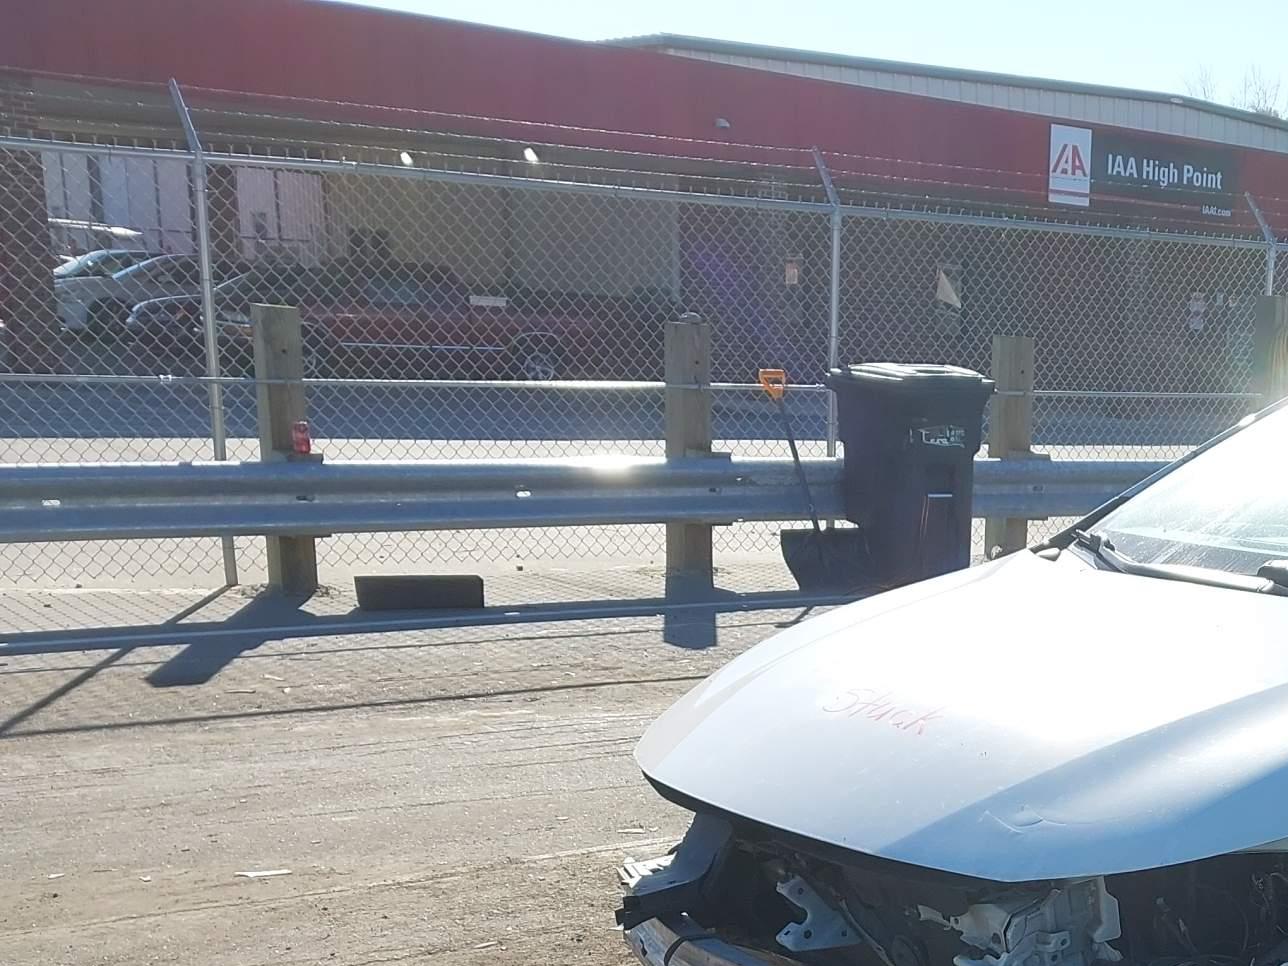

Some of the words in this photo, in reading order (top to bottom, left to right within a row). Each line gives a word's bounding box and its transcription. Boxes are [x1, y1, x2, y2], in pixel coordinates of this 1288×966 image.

[1107, 153, 1138, 178] IAA
[1142, 158, 1178, 187] High
[1183, 164, 1223, 190] Point
